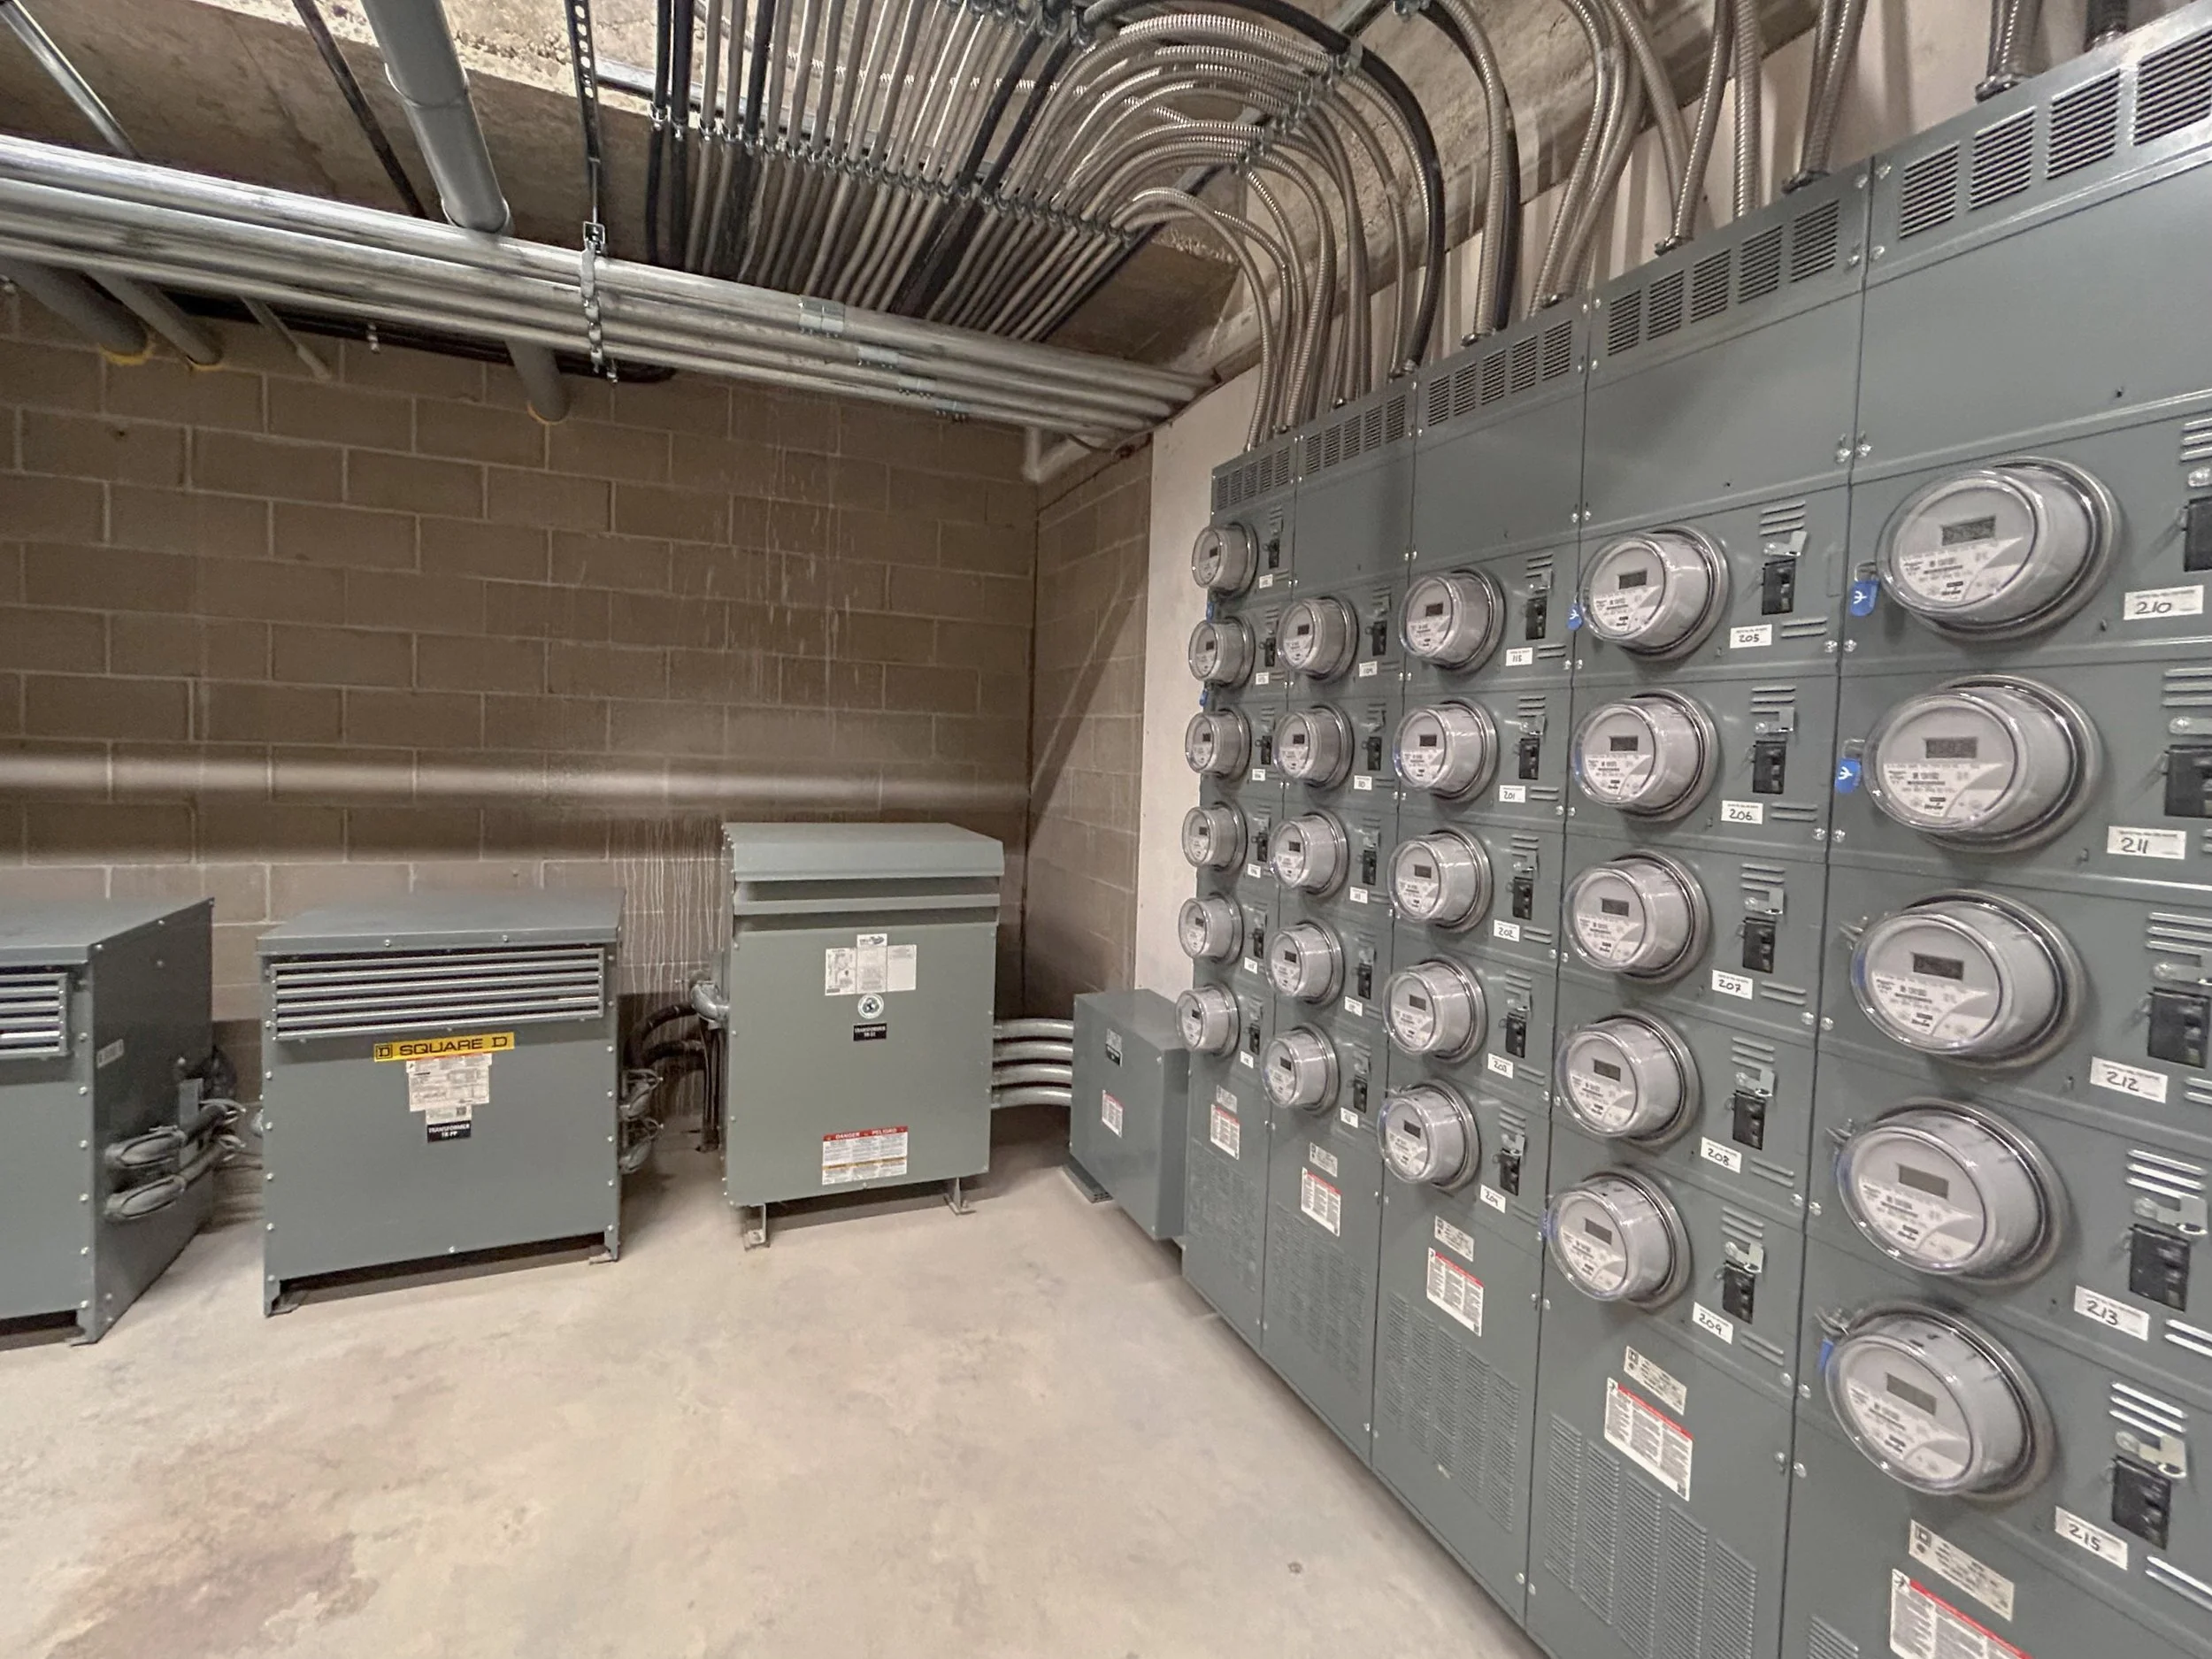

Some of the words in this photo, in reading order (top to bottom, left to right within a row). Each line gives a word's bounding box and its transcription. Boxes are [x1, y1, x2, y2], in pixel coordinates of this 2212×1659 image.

[2135, 602, 2172, 615] 210
[1738, 634, 1760, 643] 205
[1503, 790, 1516, 801] 201
[1729, 809, 1753, 821] 206
[2120, 837, 2148, 854] 211
[1498, 926, 1515, 938] 202
[1718, 979, 1741, 993] 207
[399, 1038, 483, 1056] SQUARE
[491, 1036, 508, 1048] D
[2107, 1071, 2140, 1093] 212
[1707, 1147, 1729, 1166] 208
[2086, 1300, 2119, 1326] 213
[1699, 1313, 1723, 1335] 209
[2068, 1524, 2101, 1552] 215
